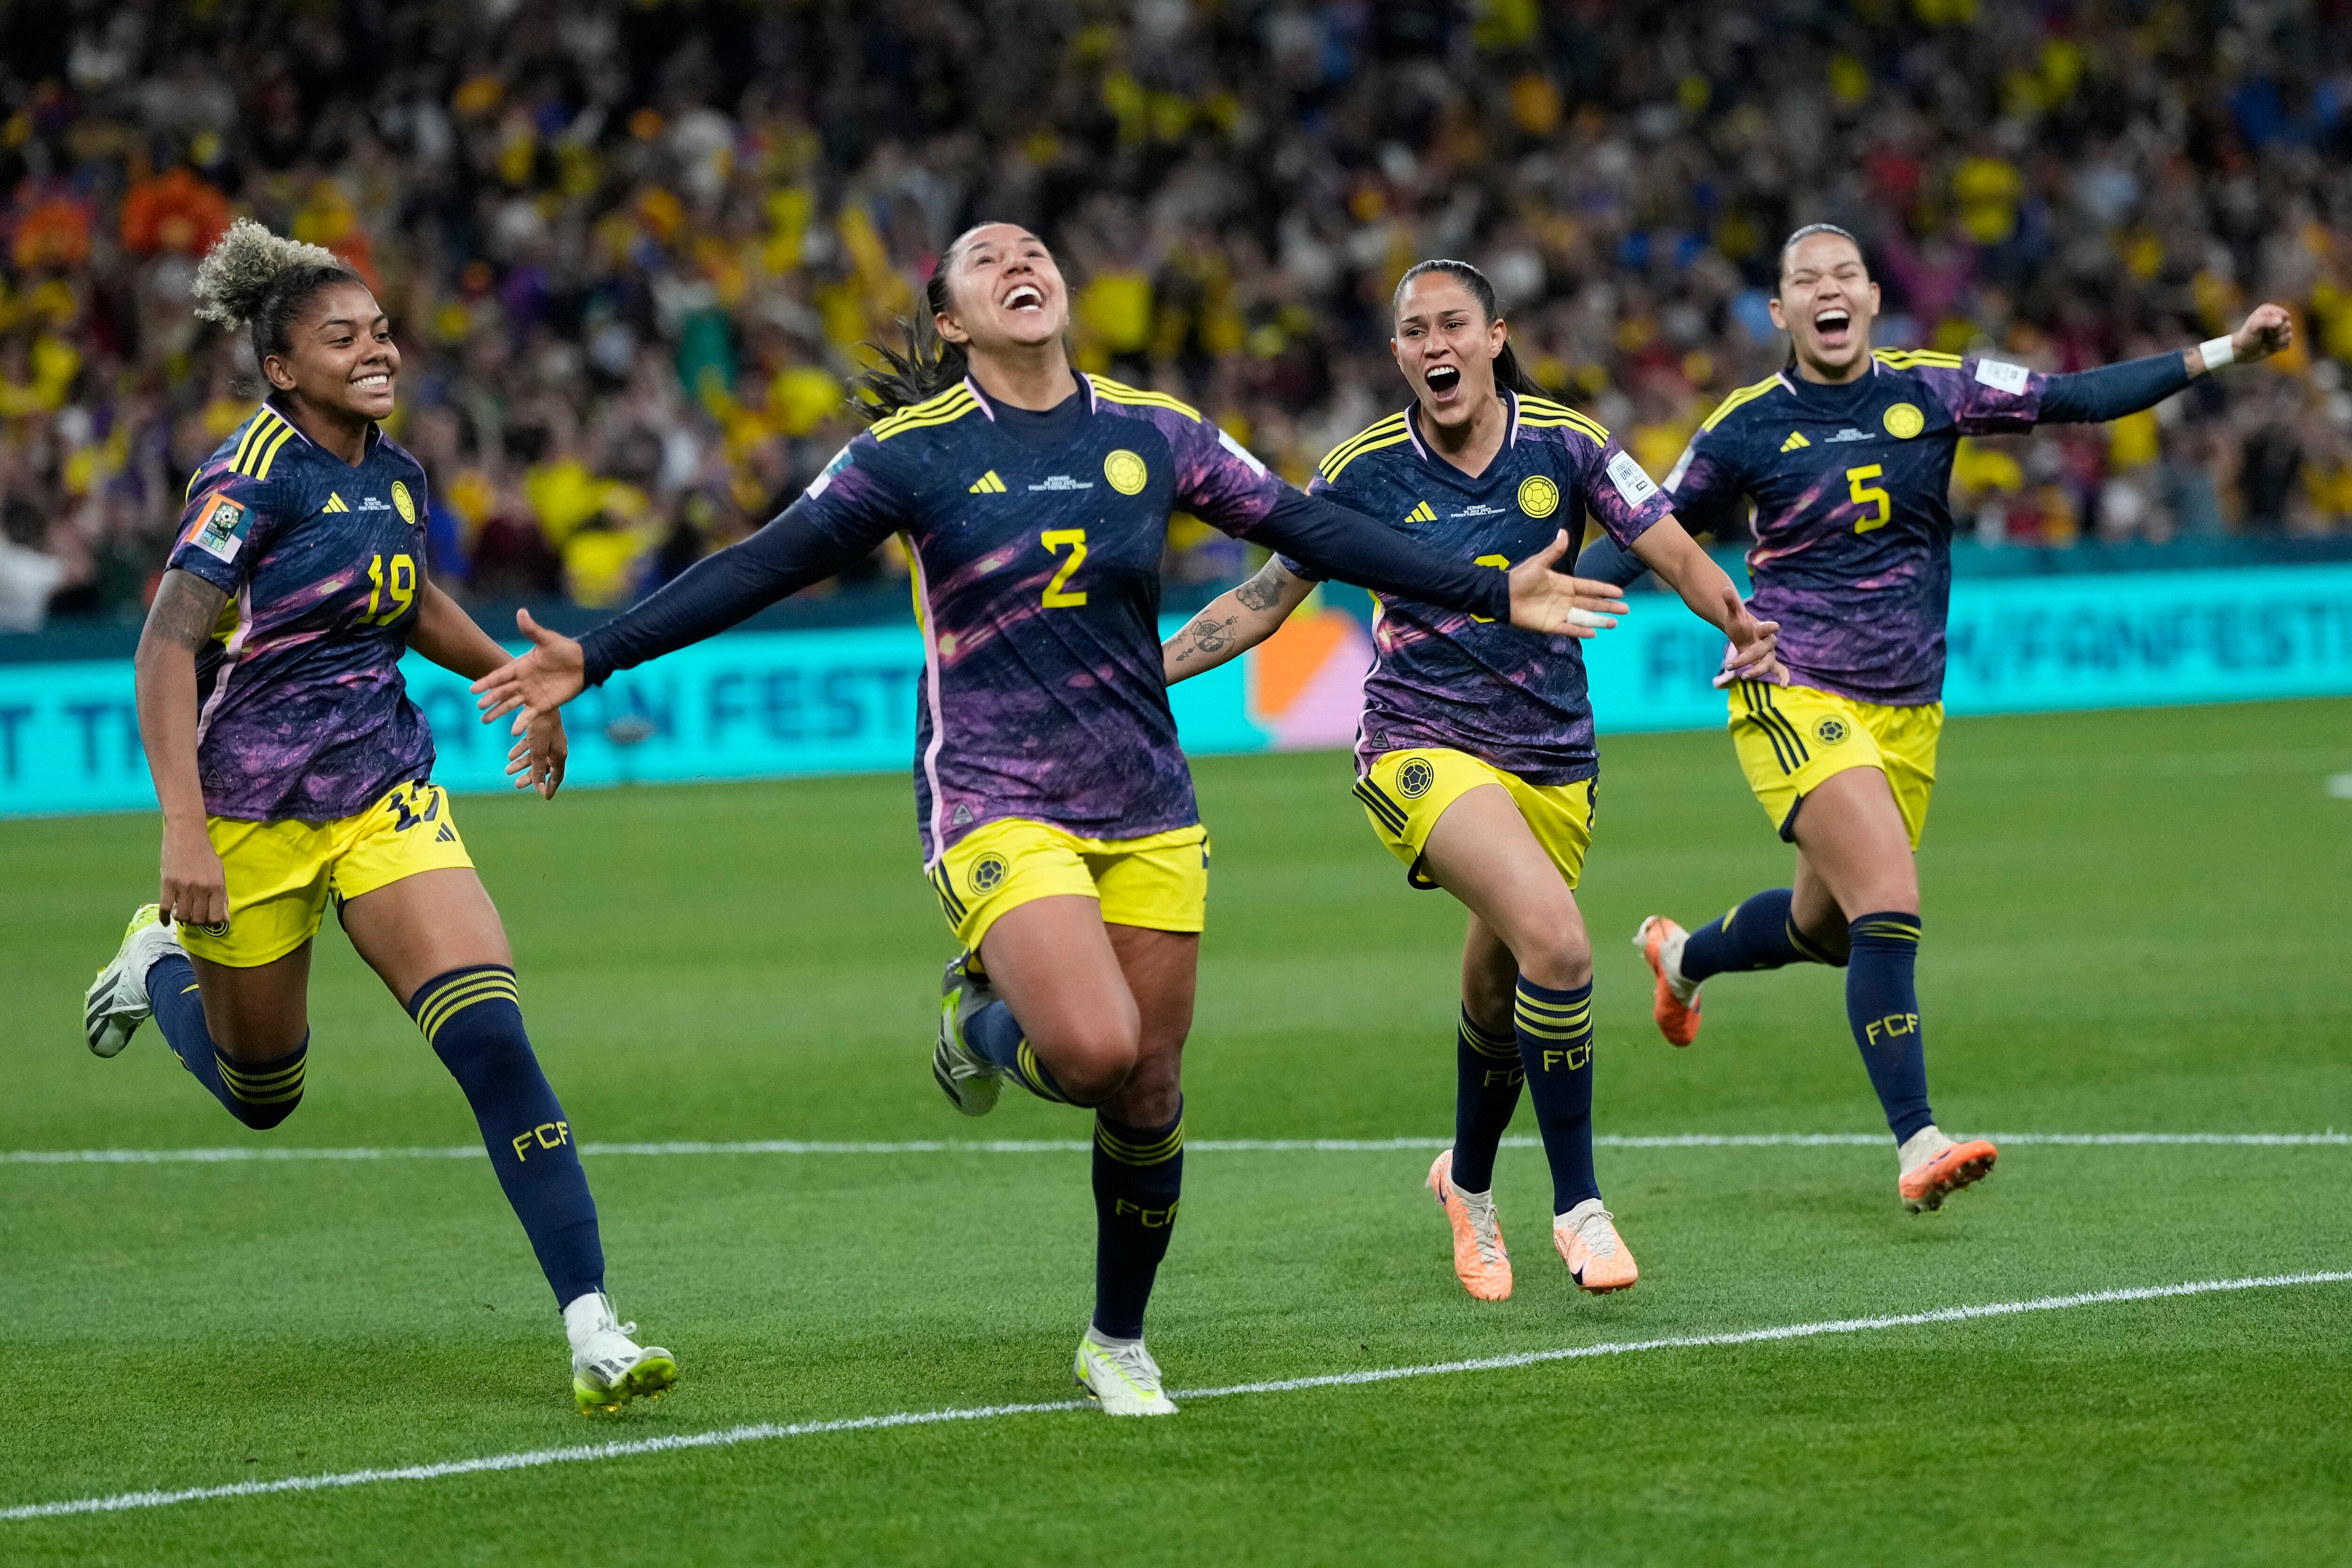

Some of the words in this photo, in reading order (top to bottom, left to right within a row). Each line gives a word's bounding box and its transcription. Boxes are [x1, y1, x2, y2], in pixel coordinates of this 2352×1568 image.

[1637, 481, 1647, 491] FIFA
[1846, 463, 1891, 534] 5
[1041, 529, 1088, 608] 2
[355, 554, 415, 626] 19
[1865, 1013, 1919, 1046] FCF
[1543, 1037, 1592, 1072] FCF
[1484, 1065, 1526, 1087] FC
[512, 1121, 568, 1162] FCF
